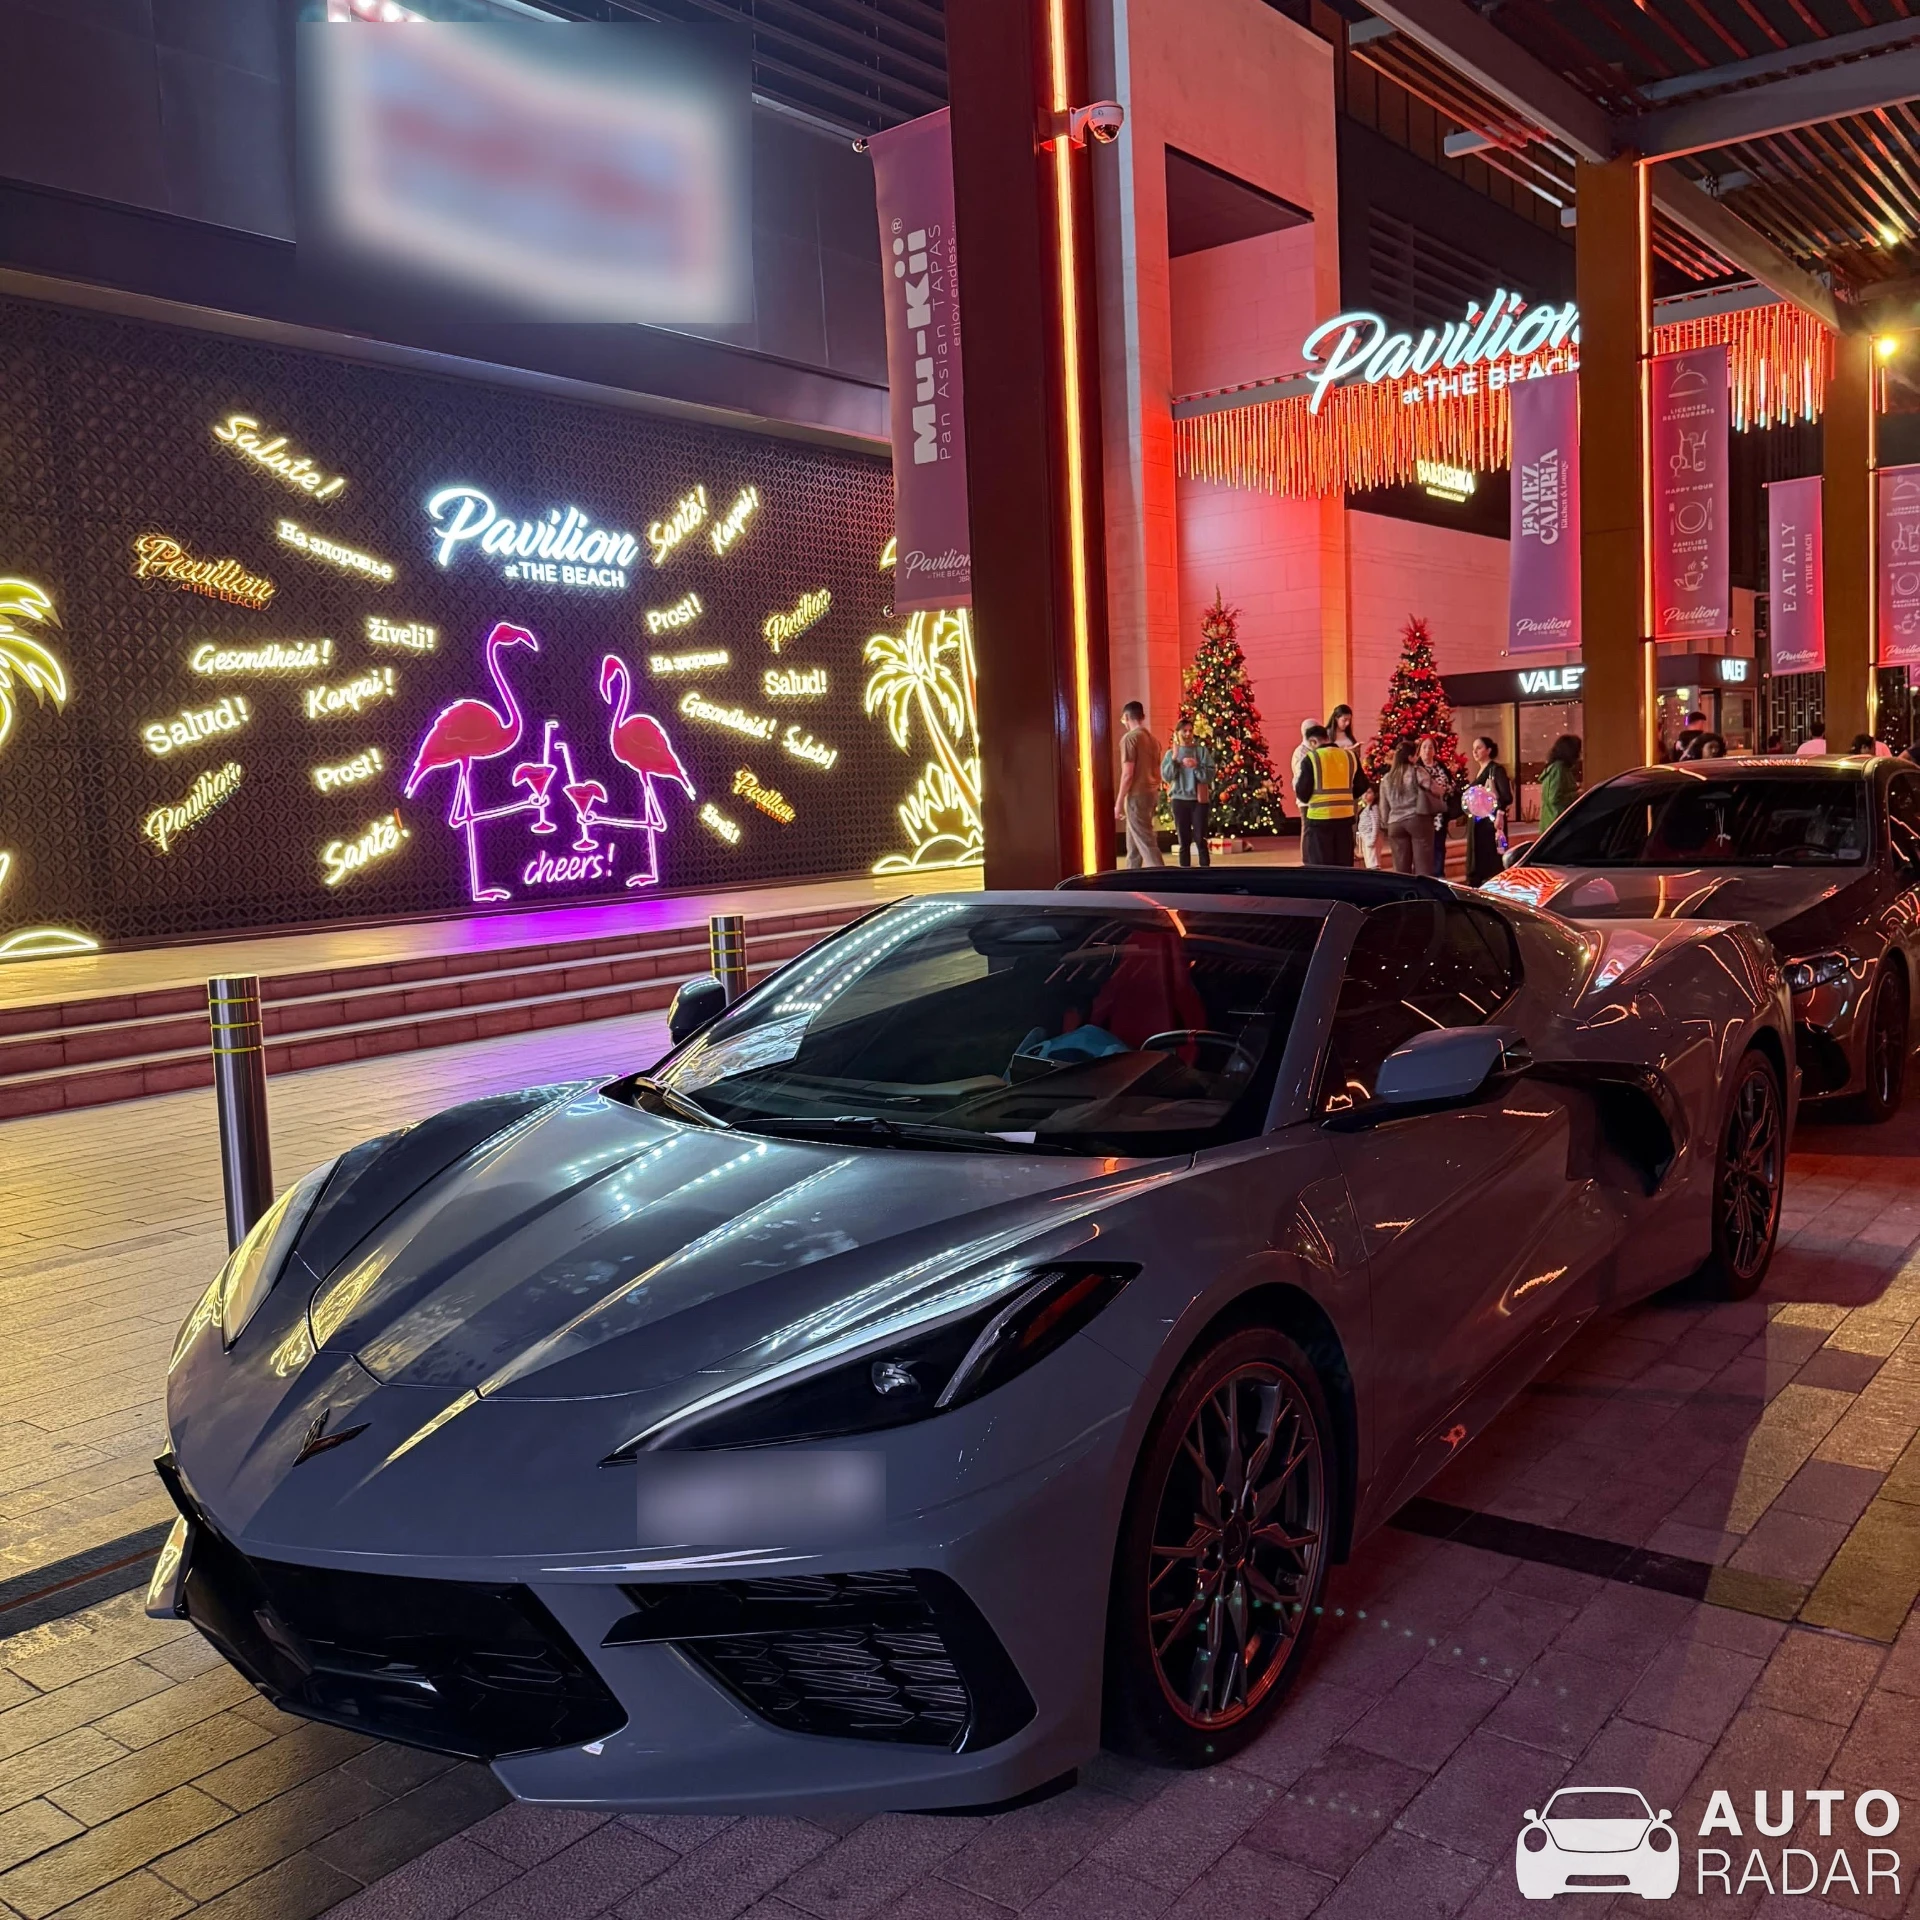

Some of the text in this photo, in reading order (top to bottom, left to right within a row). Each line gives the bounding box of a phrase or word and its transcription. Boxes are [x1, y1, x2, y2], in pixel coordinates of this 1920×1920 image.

[946, 238, 959, 300] endless
[928, 224, 953, 460] Pan Asian TAPAS
[950, 303, 961, 347] enjoy
[1302, 288, 1580, 414] Pavilion
[1402, 387, 1424, 405] at
[1424, 371, 1478, 400] THE
[1670, 403, 1707, 414] LICENSED
[1662, 408, 1715, 421] RESTAURANTS
[213, 415, 345, 497] Salute!
[1560, 489, 1568, 498] &
[1665, 483, 1714, 495] HAPPY HOUR
[429, 487, 638, 567] Pavilion
[649, 484, 708, 565] Santé!
[1672, 538, 1708, 548] FAMILIES
[136, 533, 276, 601] Pavilion
[308, 537, 393, 580] здоровье
[904, 548, 971, 579] Pavilion
[1671, 544, 1709, 554] WELCOME
[1781, 523, 1797, 613] EATALY
[1804, 533, 1814, 596] AT THE BEACH
[504, 561, 625, 588] at THE BEACH
[932, 571, 946, 579] THE
[946, 569, 970, 578] BEACH
[191, 581, 218, 599] THE
[219, 588, 262, 611] BEACH
[647, 592, 703, 634] Prost!
[1662, 605, 1720, 626] Pavilion
[1516, 616, 1572, 636] Pavilion
[1776, 649, 1819, 664] Pavilion
[308, 667, 394, 719] Kanpai!
[764, 668, 828, 697] Salud!
[145, 696, 249, 754] Salud!
[314, 748, 383, 792] Prost!
[782, 725, 838, 781] Salute!
[145, 762, 242, 852] Pavilion
[732, 769, 797, 823] Pavilion
[324, 807, 410, 886] Santé!
[523, 842, 616, 885] cheers!
